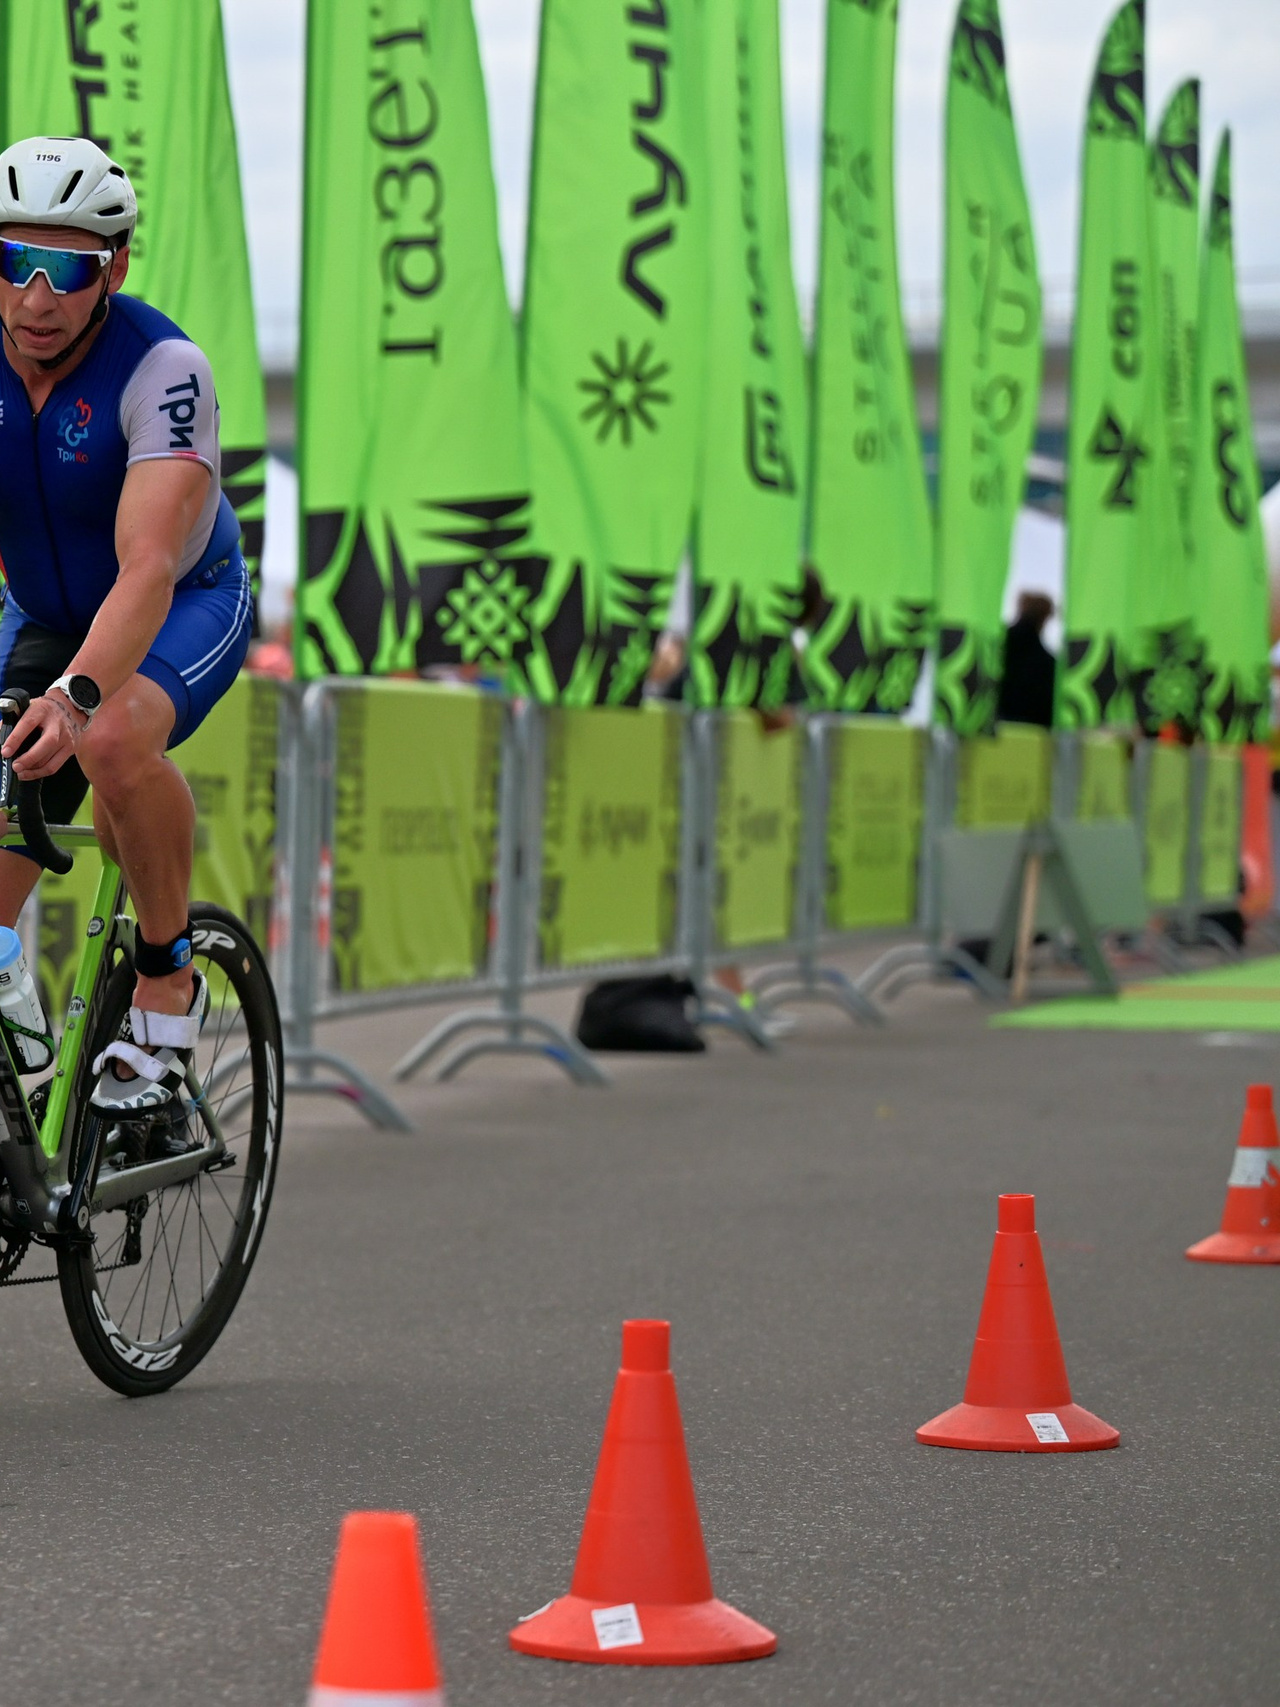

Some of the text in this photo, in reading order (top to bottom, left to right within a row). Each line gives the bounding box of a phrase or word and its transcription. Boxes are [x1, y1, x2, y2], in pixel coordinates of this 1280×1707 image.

[36, 154, 61, 162] 1196
[158, 373, 200, 449] Три
[0, 756, 8, 801] TEGRA
[192, 929, 237, 950] PP
[91, 1289, 183, 1372] ZIPP
